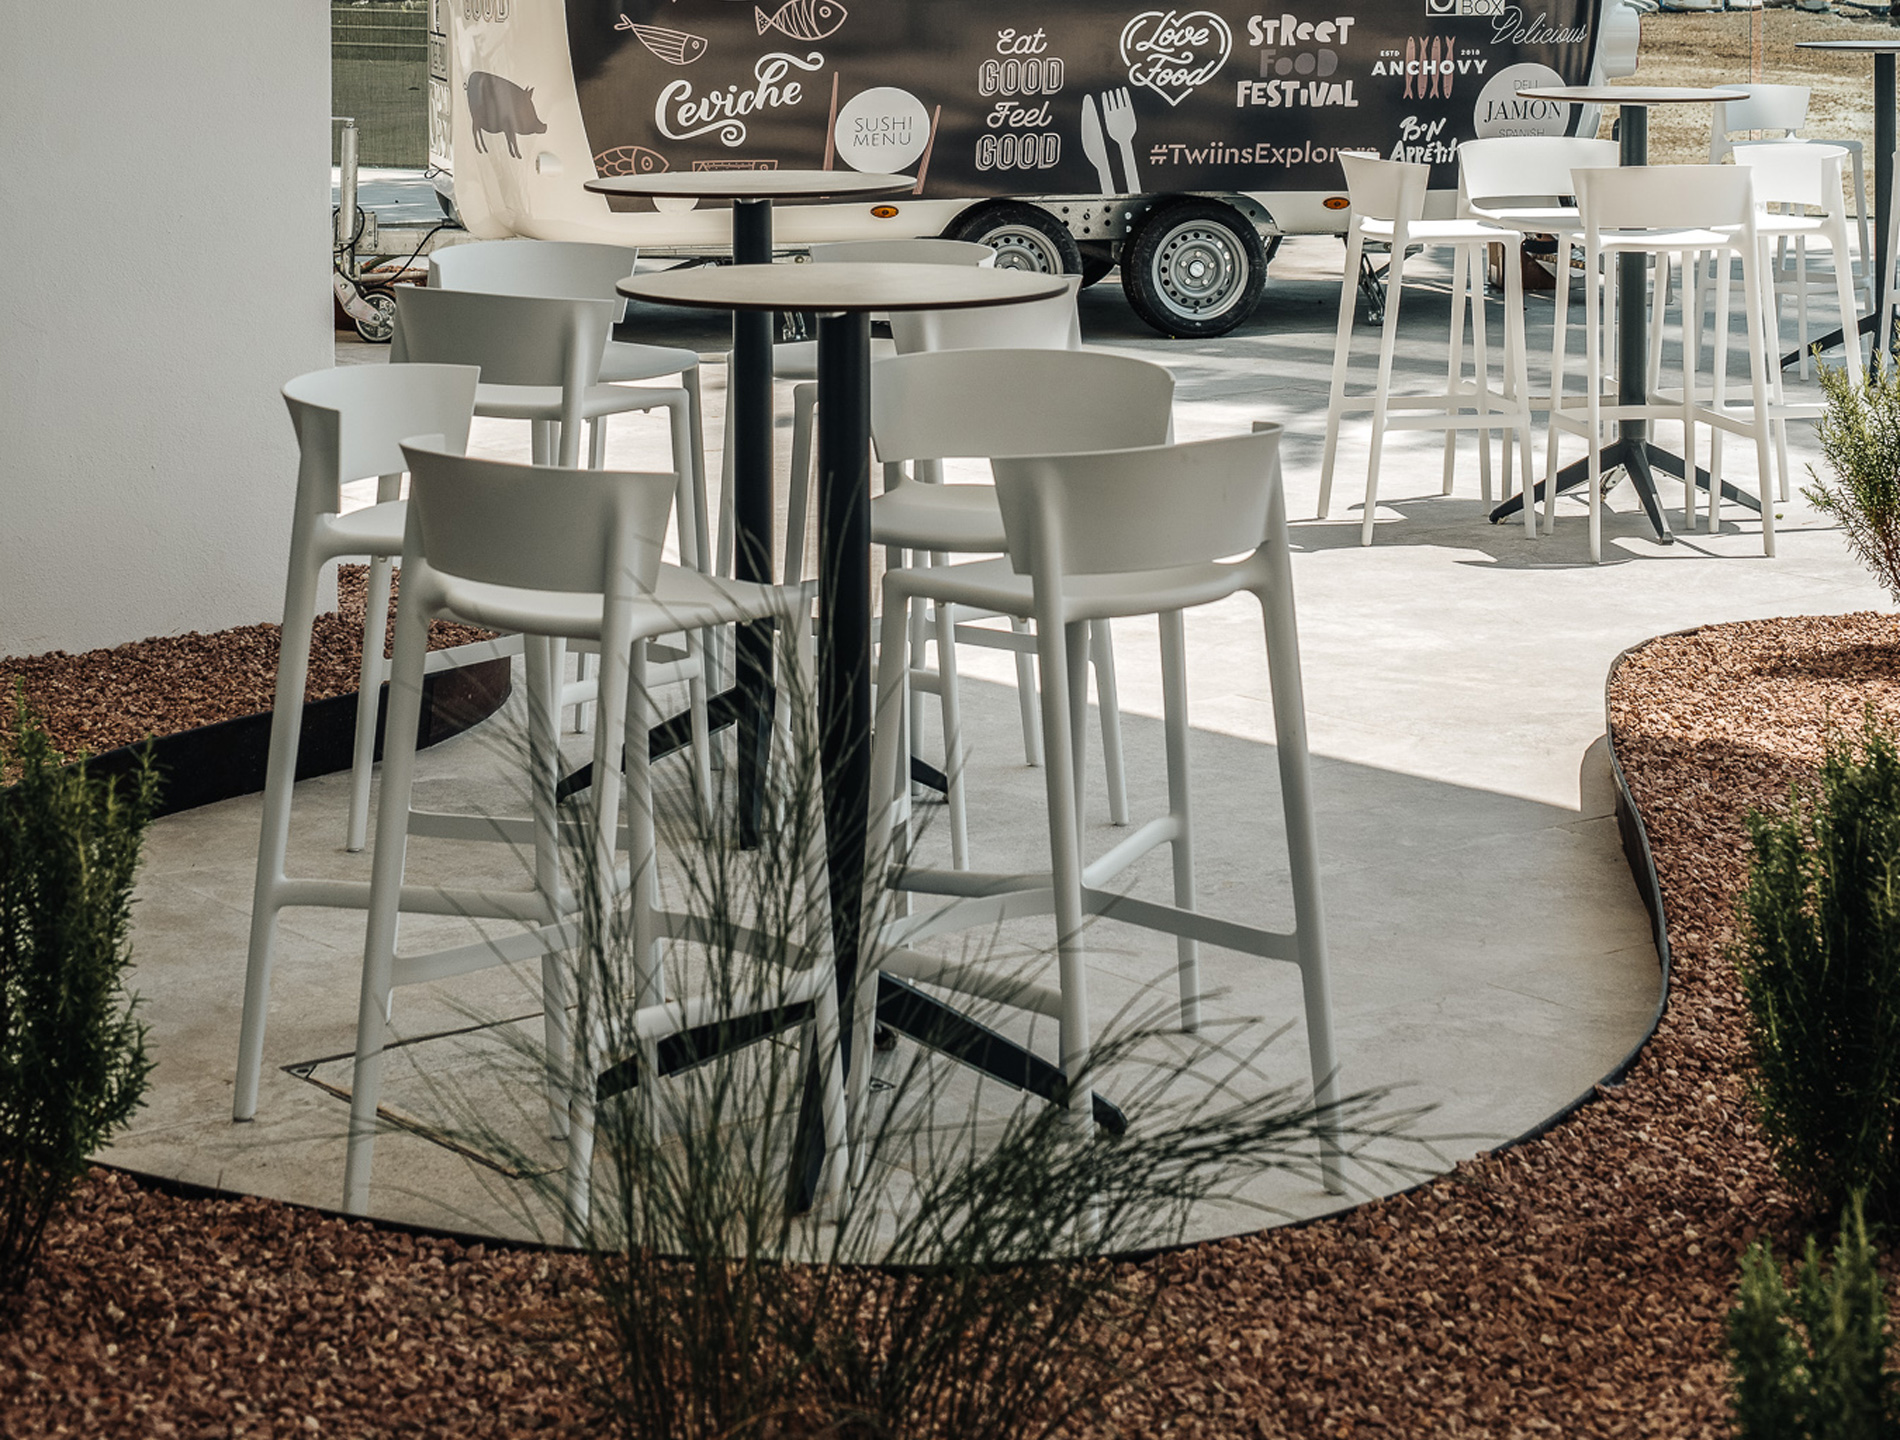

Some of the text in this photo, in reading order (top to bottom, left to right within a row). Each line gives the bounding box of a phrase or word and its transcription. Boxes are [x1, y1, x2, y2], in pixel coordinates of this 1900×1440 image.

[996, 27, 1048, 55] Eat
[1135, 10, 1210, 53] Love
[1490, 5, 1589, 45] Delicious
[978, 58, 1065, 98] GOOD
[1128, 51, 1216, 87] Food
[1371, 59, 1488, 77] ANCHOVY
[655, 51, 825, 147] Ceviche
[986, 101, 1053, 129] Feel
[852, 130, 912, 147] MENU
[854, 115, 913, 133] SUSHI
[975, 132, 1061, 172] GOOD
[1150, 140, 1377, 168] #TwiinsExplor
